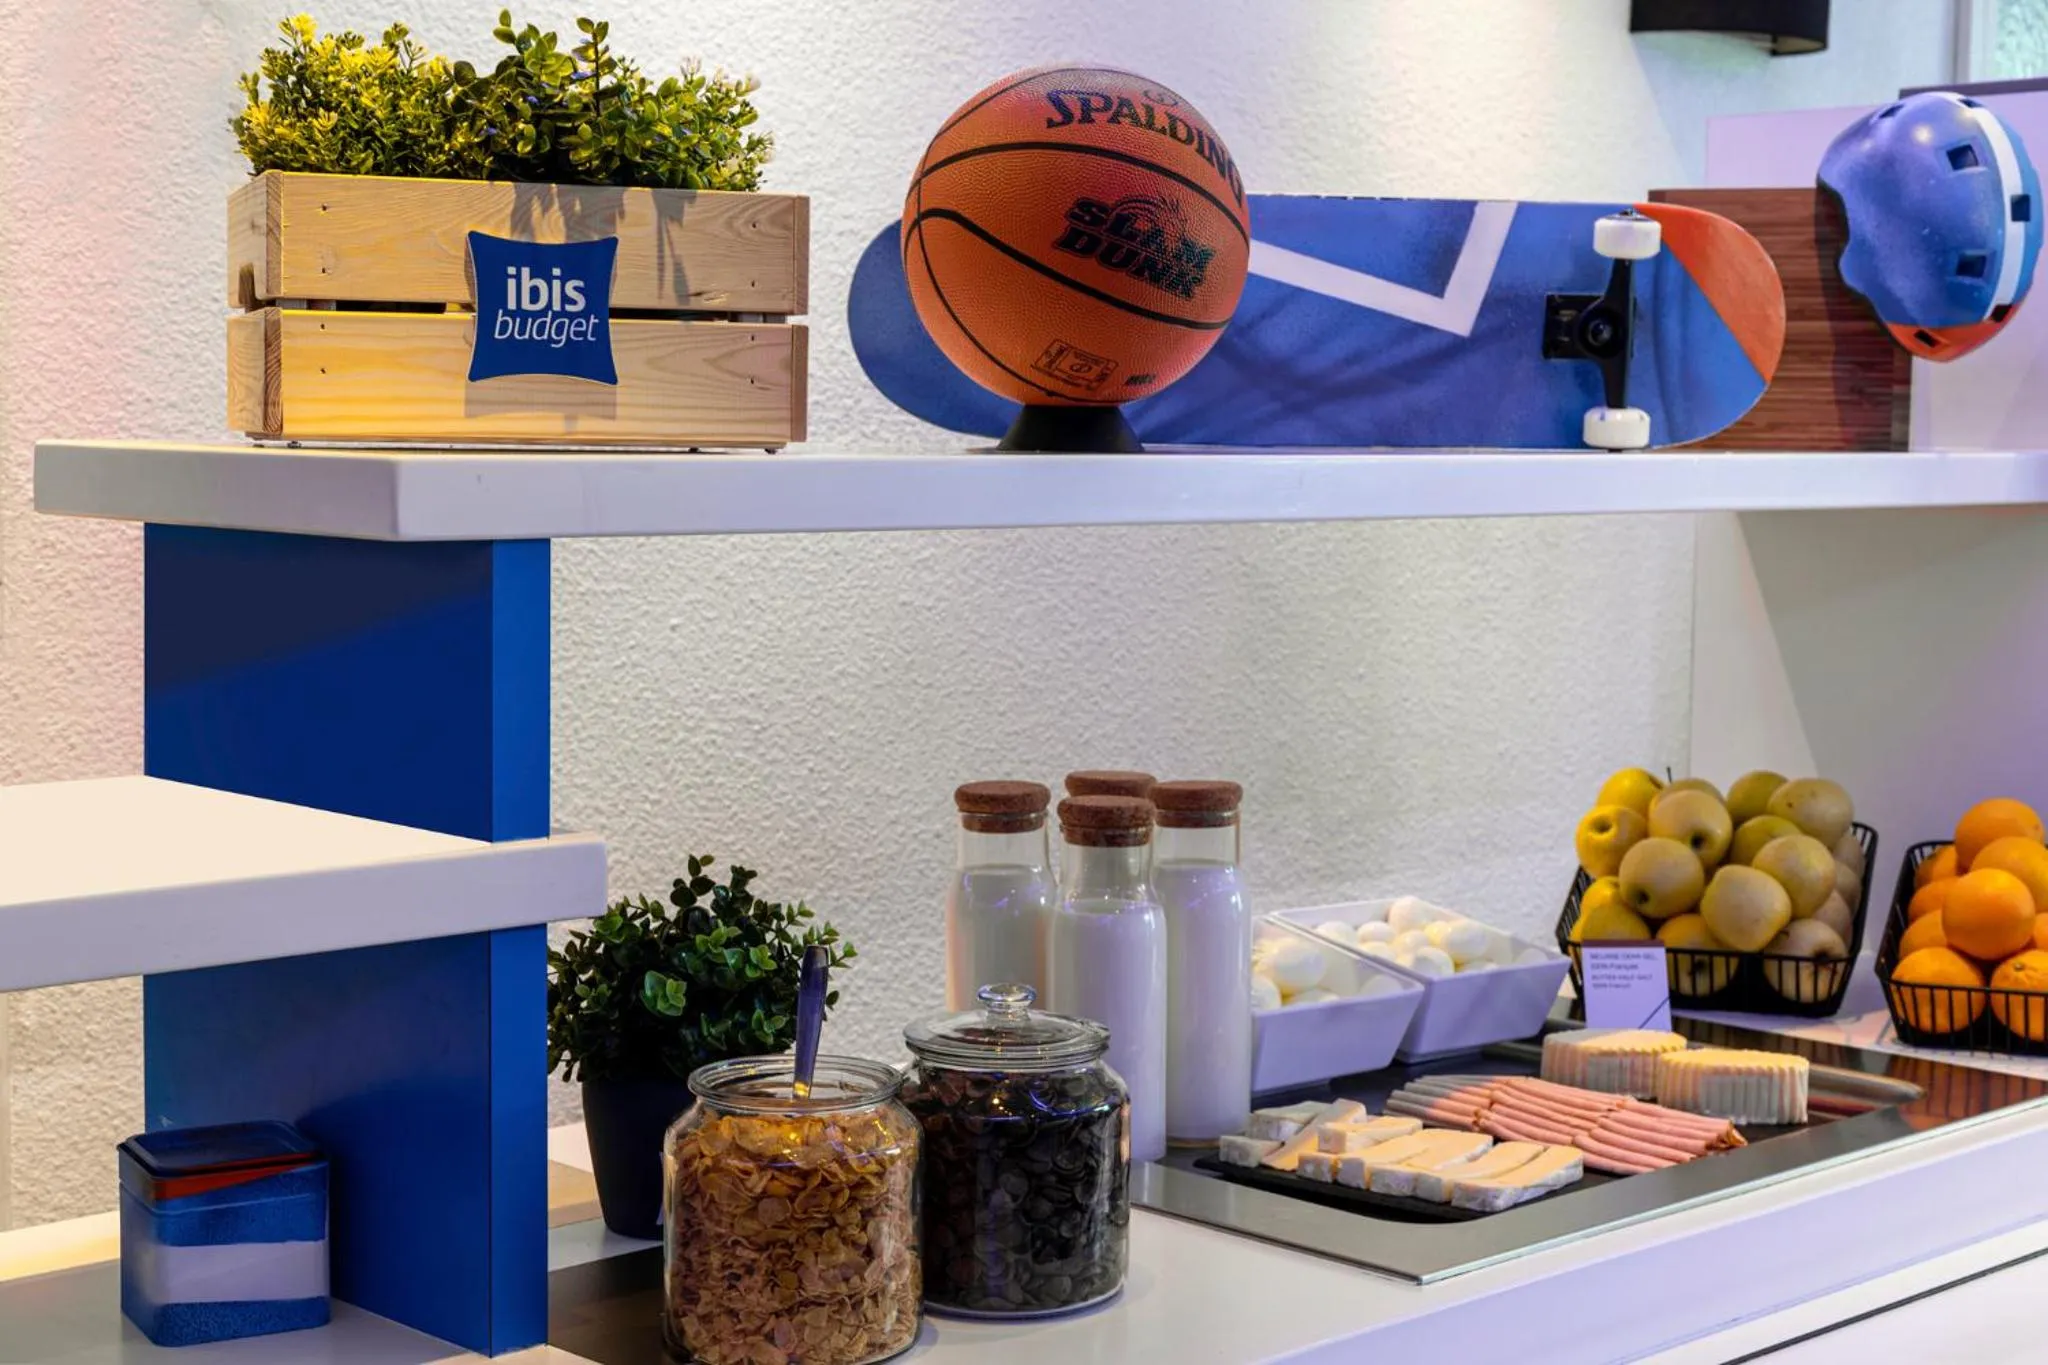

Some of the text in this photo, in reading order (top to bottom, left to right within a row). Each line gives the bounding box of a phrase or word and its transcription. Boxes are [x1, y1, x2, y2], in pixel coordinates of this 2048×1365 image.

[1046, 89, 1243, 208] SPALDING
[1055, 224, 1205, 299] DUNK
[1064, 196, 1215, 270] SLAM
[507, 266, 586, 312] ibis
[494, 309, 599, 348] budget
